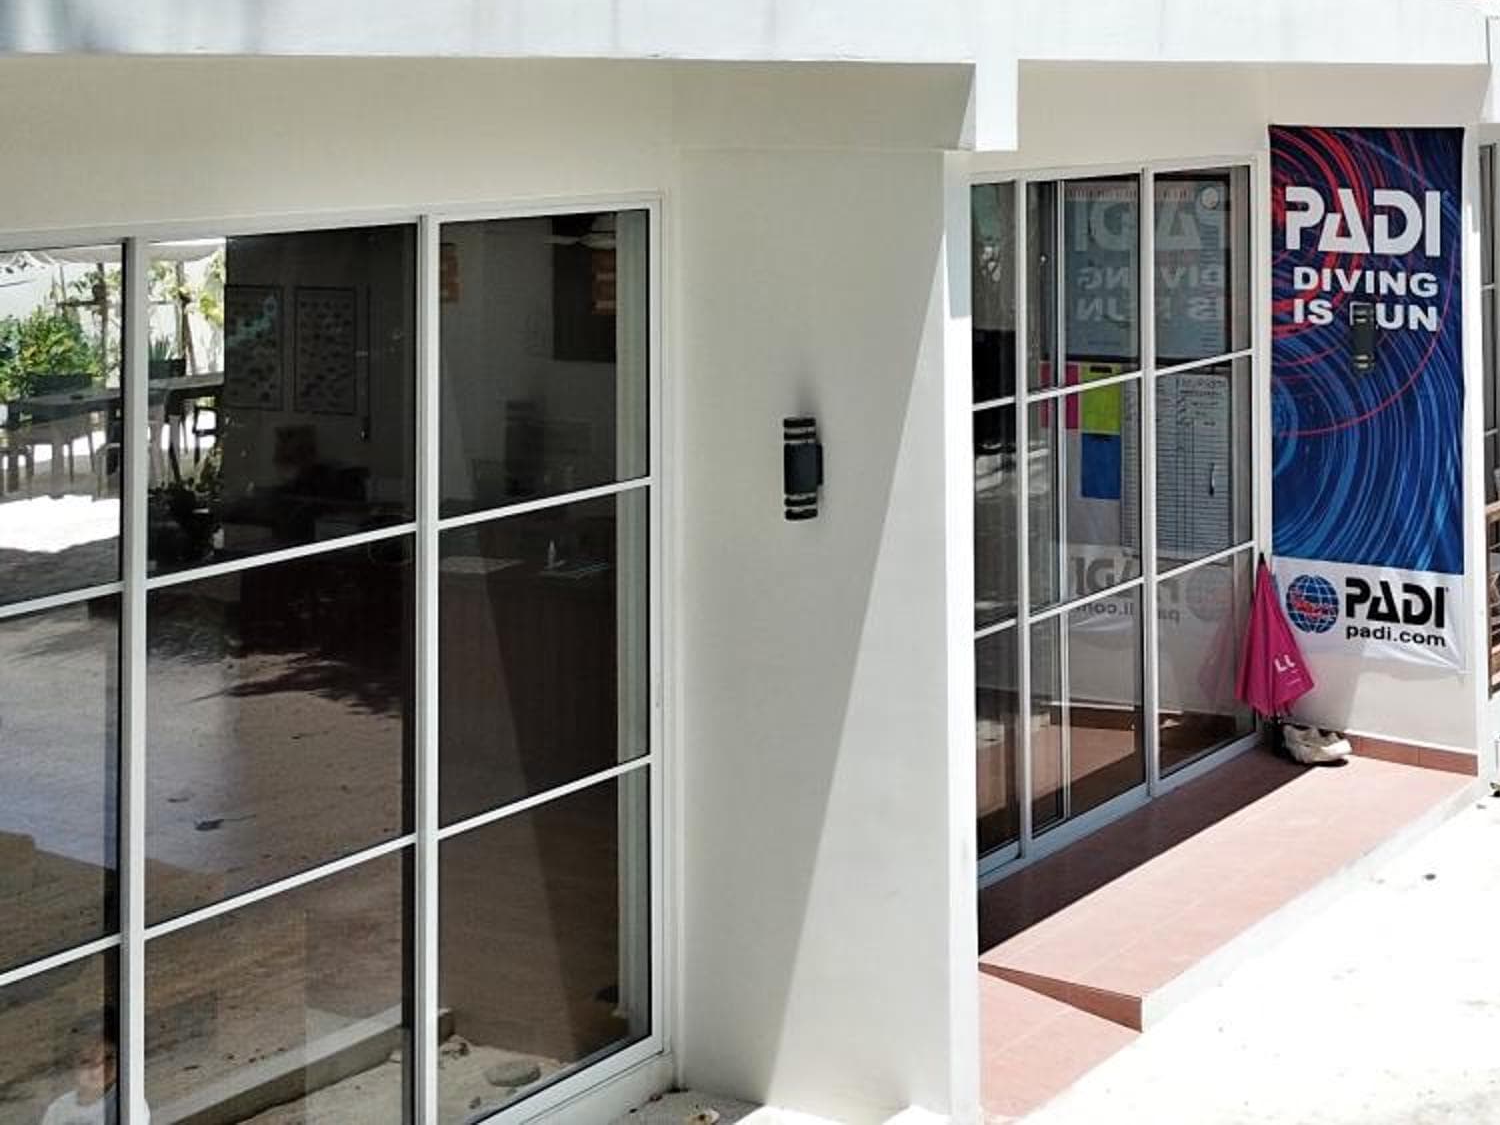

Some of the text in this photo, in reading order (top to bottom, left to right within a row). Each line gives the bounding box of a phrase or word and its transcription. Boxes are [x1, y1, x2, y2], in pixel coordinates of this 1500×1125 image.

[1285, 186, 1441, 257] PADI
[1293, 266, 1438, 298] DIVING
[1293, 299, 1333, 325] IS
[1345, 577, 1446, 628] PADI
[1345, 625, 1446, 647] padi.com
